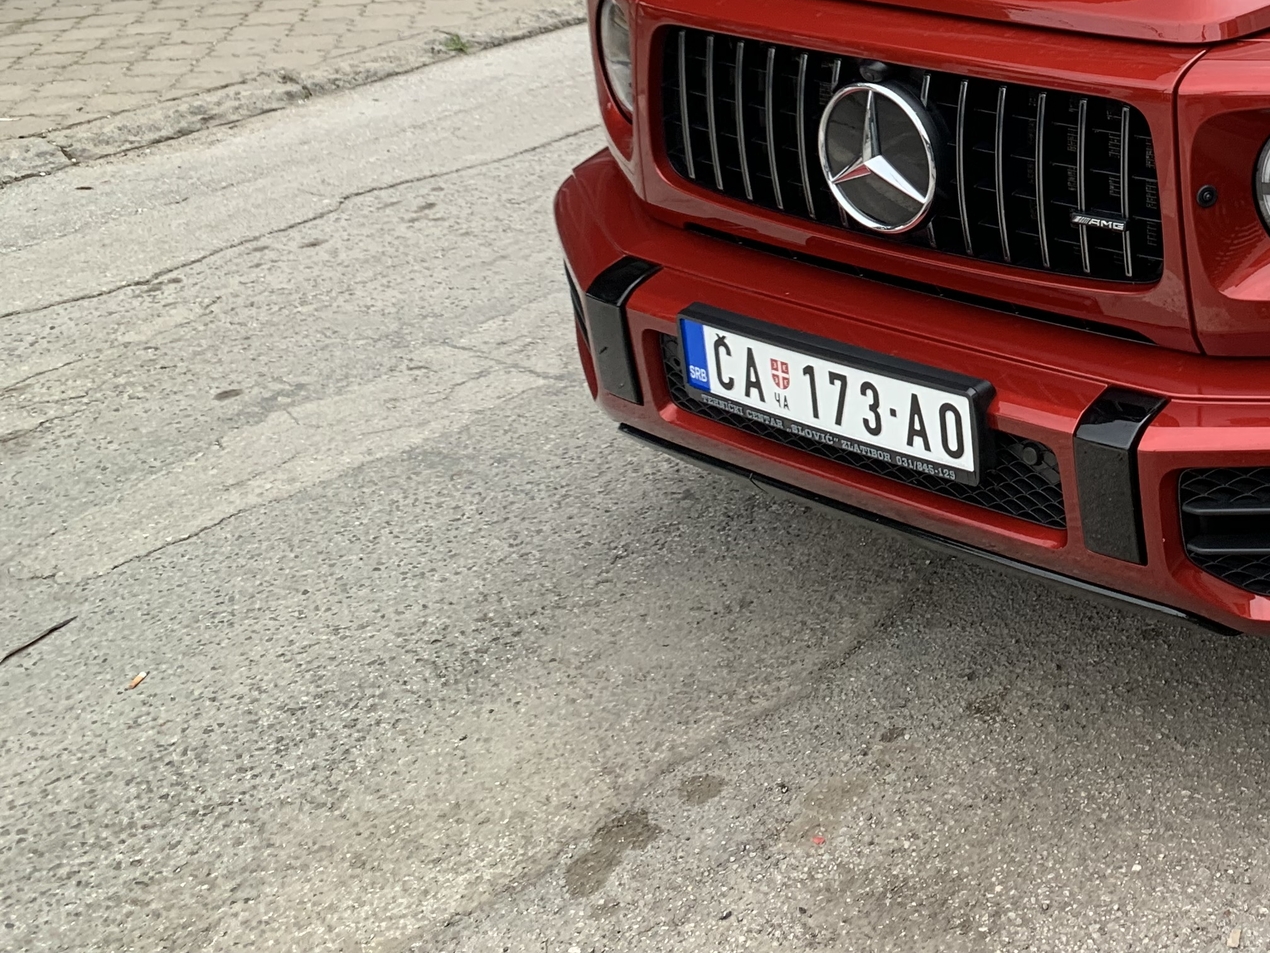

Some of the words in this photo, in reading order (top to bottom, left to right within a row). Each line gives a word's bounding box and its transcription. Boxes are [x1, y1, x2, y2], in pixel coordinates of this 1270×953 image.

[1088, 218, 1124, 230] AMG
[689, 364, 708, 382] SRB
[713, 333, 766, 403] ČA
[700, 393, 744, 417] TEHNIČKI
[746, 408, 784, 430] CENTAR
[840, 439, 892, 464] ZLATIBOR
